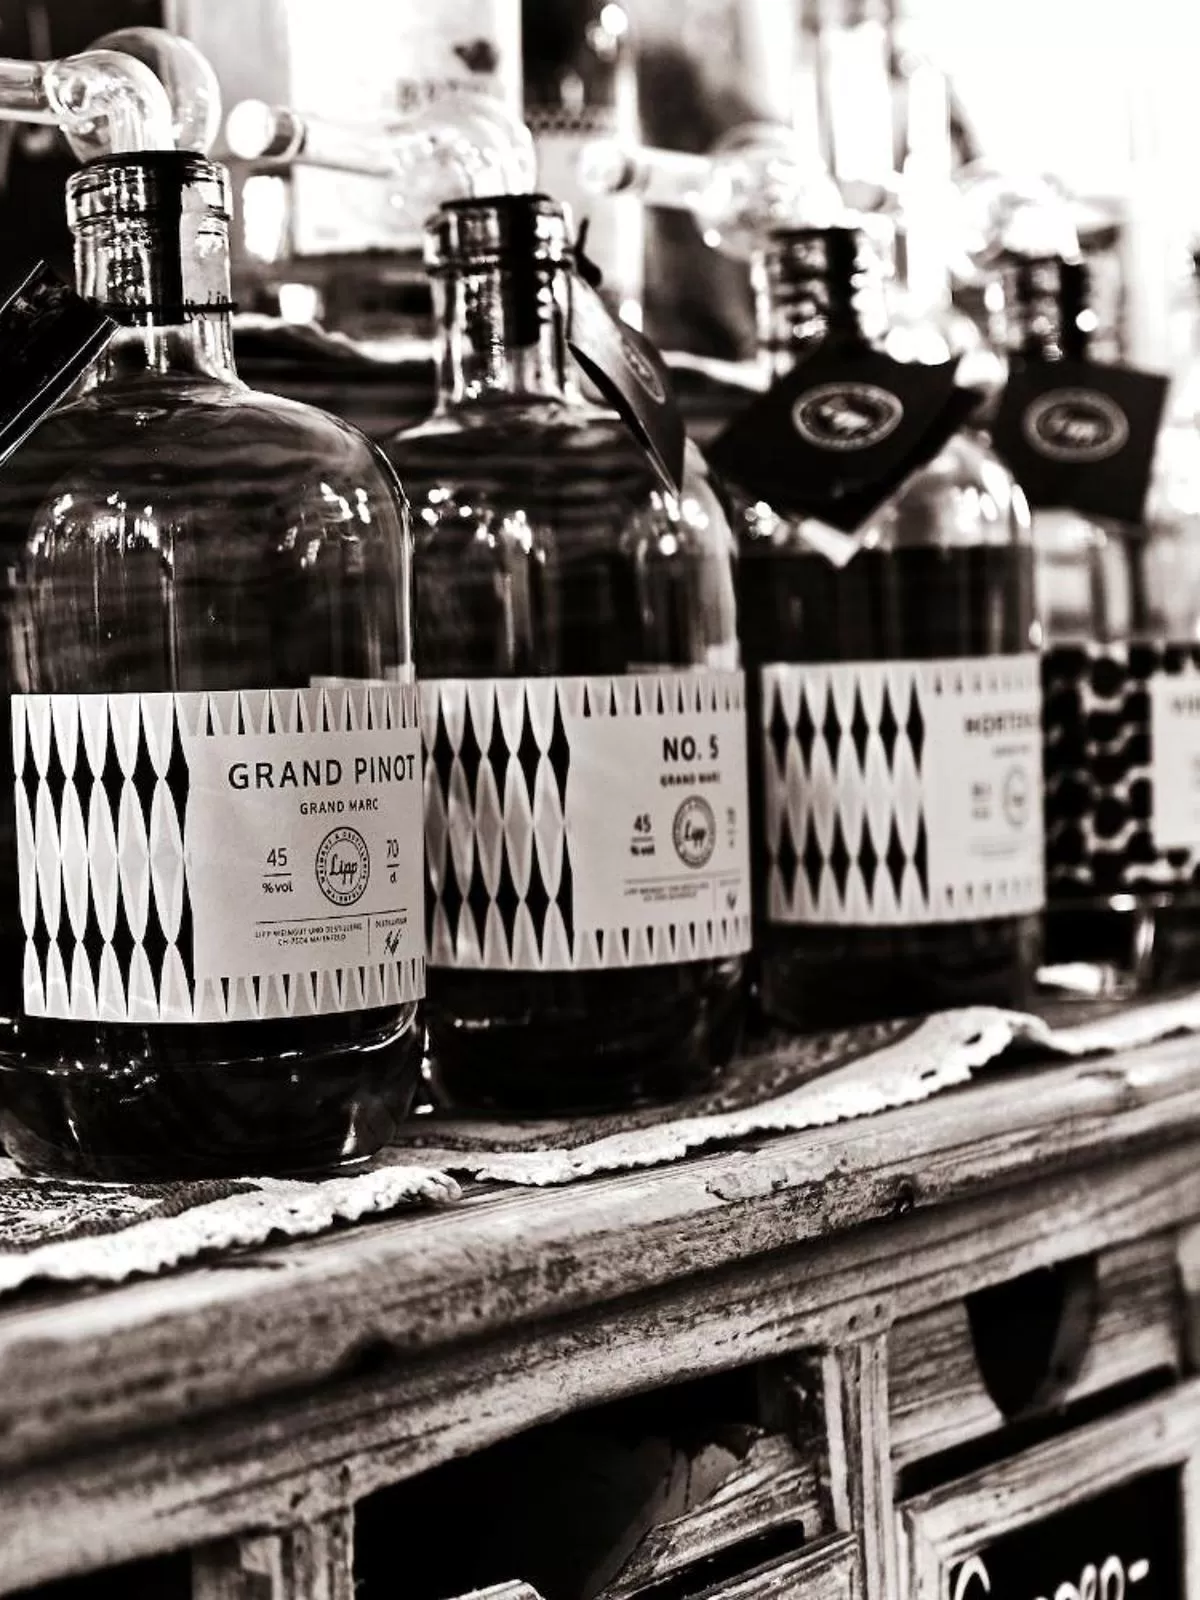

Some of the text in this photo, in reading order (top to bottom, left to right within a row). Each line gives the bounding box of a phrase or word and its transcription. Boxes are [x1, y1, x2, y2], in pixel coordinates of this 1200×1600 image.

[663, 736, 702, 762] NO.
[228, 754, 415, 790] GRAND PINOT
[300, 798, 379, 815] GRAND MARC
[633, 813, 652, 833] 45
[266, 847, 288, 867] 45
[386, 839, 400, 859] 70
[329, 853, 358, 885] Lipp
